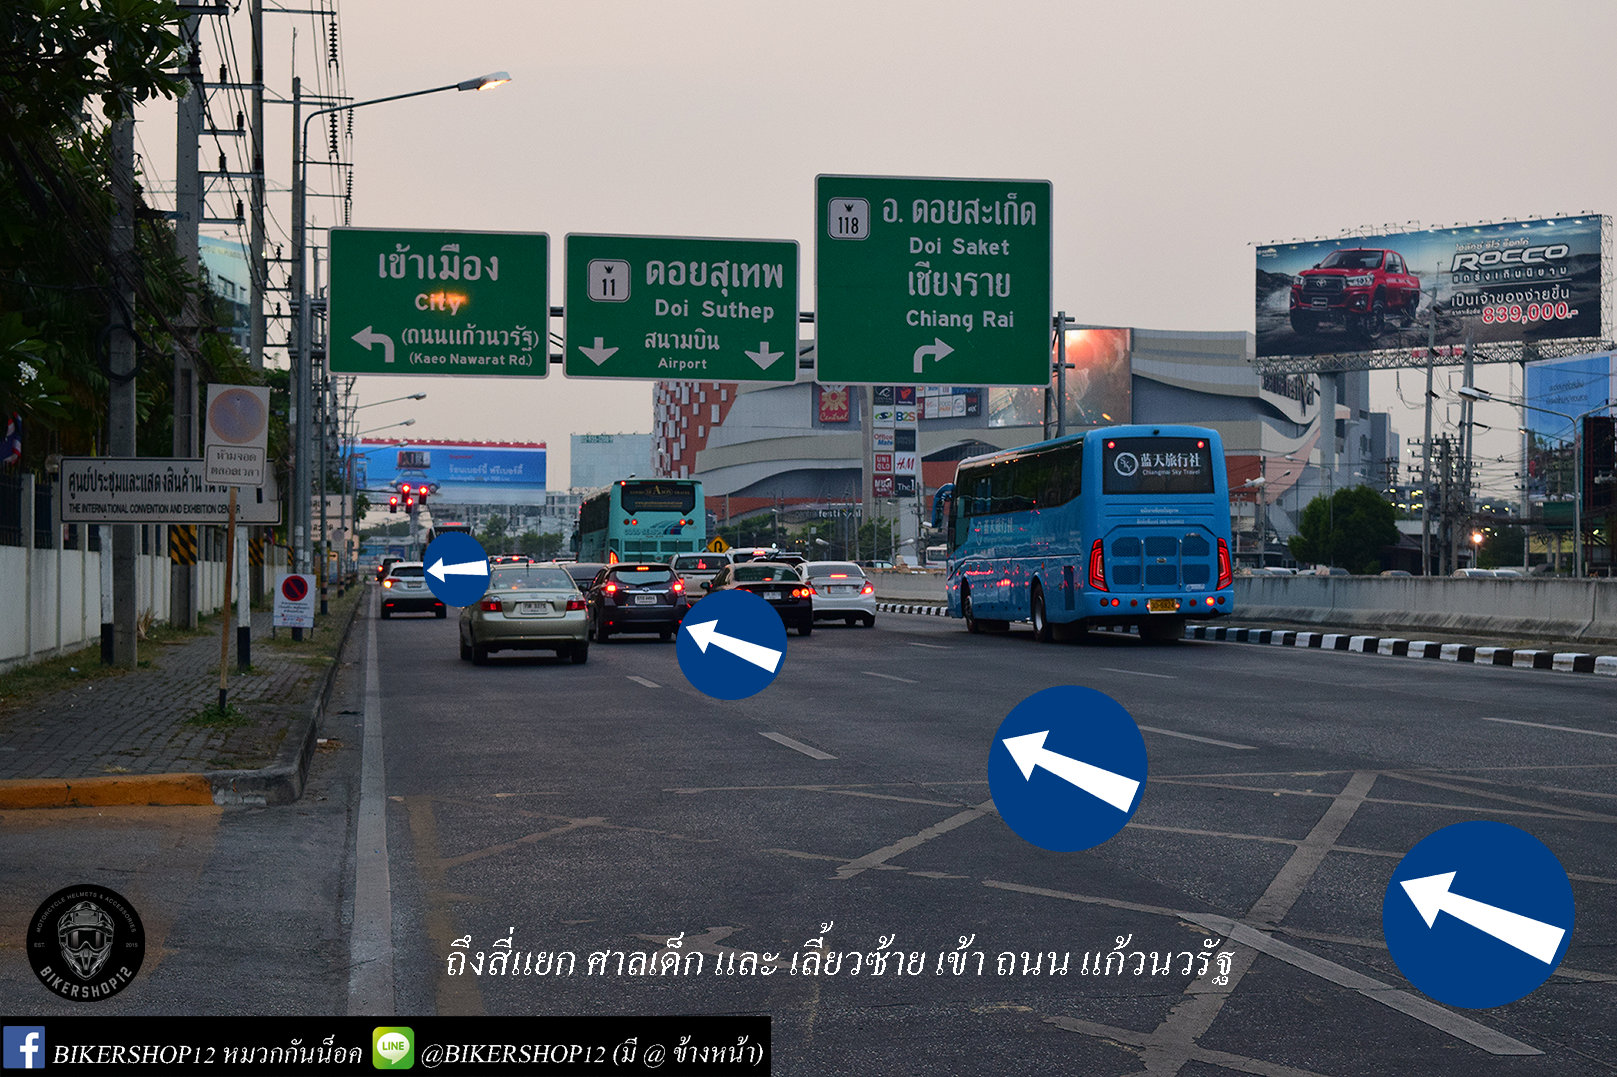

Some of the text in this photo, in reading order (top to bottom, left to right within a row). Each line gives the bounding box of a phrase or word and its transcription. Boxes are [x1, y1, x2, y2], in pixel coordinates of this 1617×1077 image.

[883, 192, 1036, 226] อ. ดอยสะเก็ด
[838, 216, 859, 234] 118
[909, 237, 1010, 255] Doi Saket
[378, 243, 499, 282] เข้าเมือง
[1452, 244, 1569, 272] ROCCO
[601, 278, 615, 296] 11
[646, 260, 783, 298] ดอยสุเทพ
[908, 261, 1011, 297] เชียงราย
[415, 291, 462, 316] City
[1452, 284, 1570, 307] เป็นเจ้าของง่ายขึ้น
[655, 299, 775, 323] Doi Suthep
[906, 309, 1014, 332] Chiang Rai
[1482, 302, 1579, 324] 839,000.-
[402, 323, 539, 351] (ถนนแก้วนวรัฐ)
[644, 328, 720, 350] สนามบิน
[409, 351, 533, 367] (Kaeo Nawarat Rd.)
[658, 357, 707, 371] Airport
[820, 411, 849, 421] Central
[896, 411, 915, 421] B2S
[1140, 453, 1201, 467] 蓝天旅行社
[69, 503, 81, 513] THE
[81, 503, 129, 513] INTERNATIONAL
[129, 503, 169, 513] CONVENTION
[169, 503, 183, 513] AND
[183, 504, 217, 513] EXHIBITION
